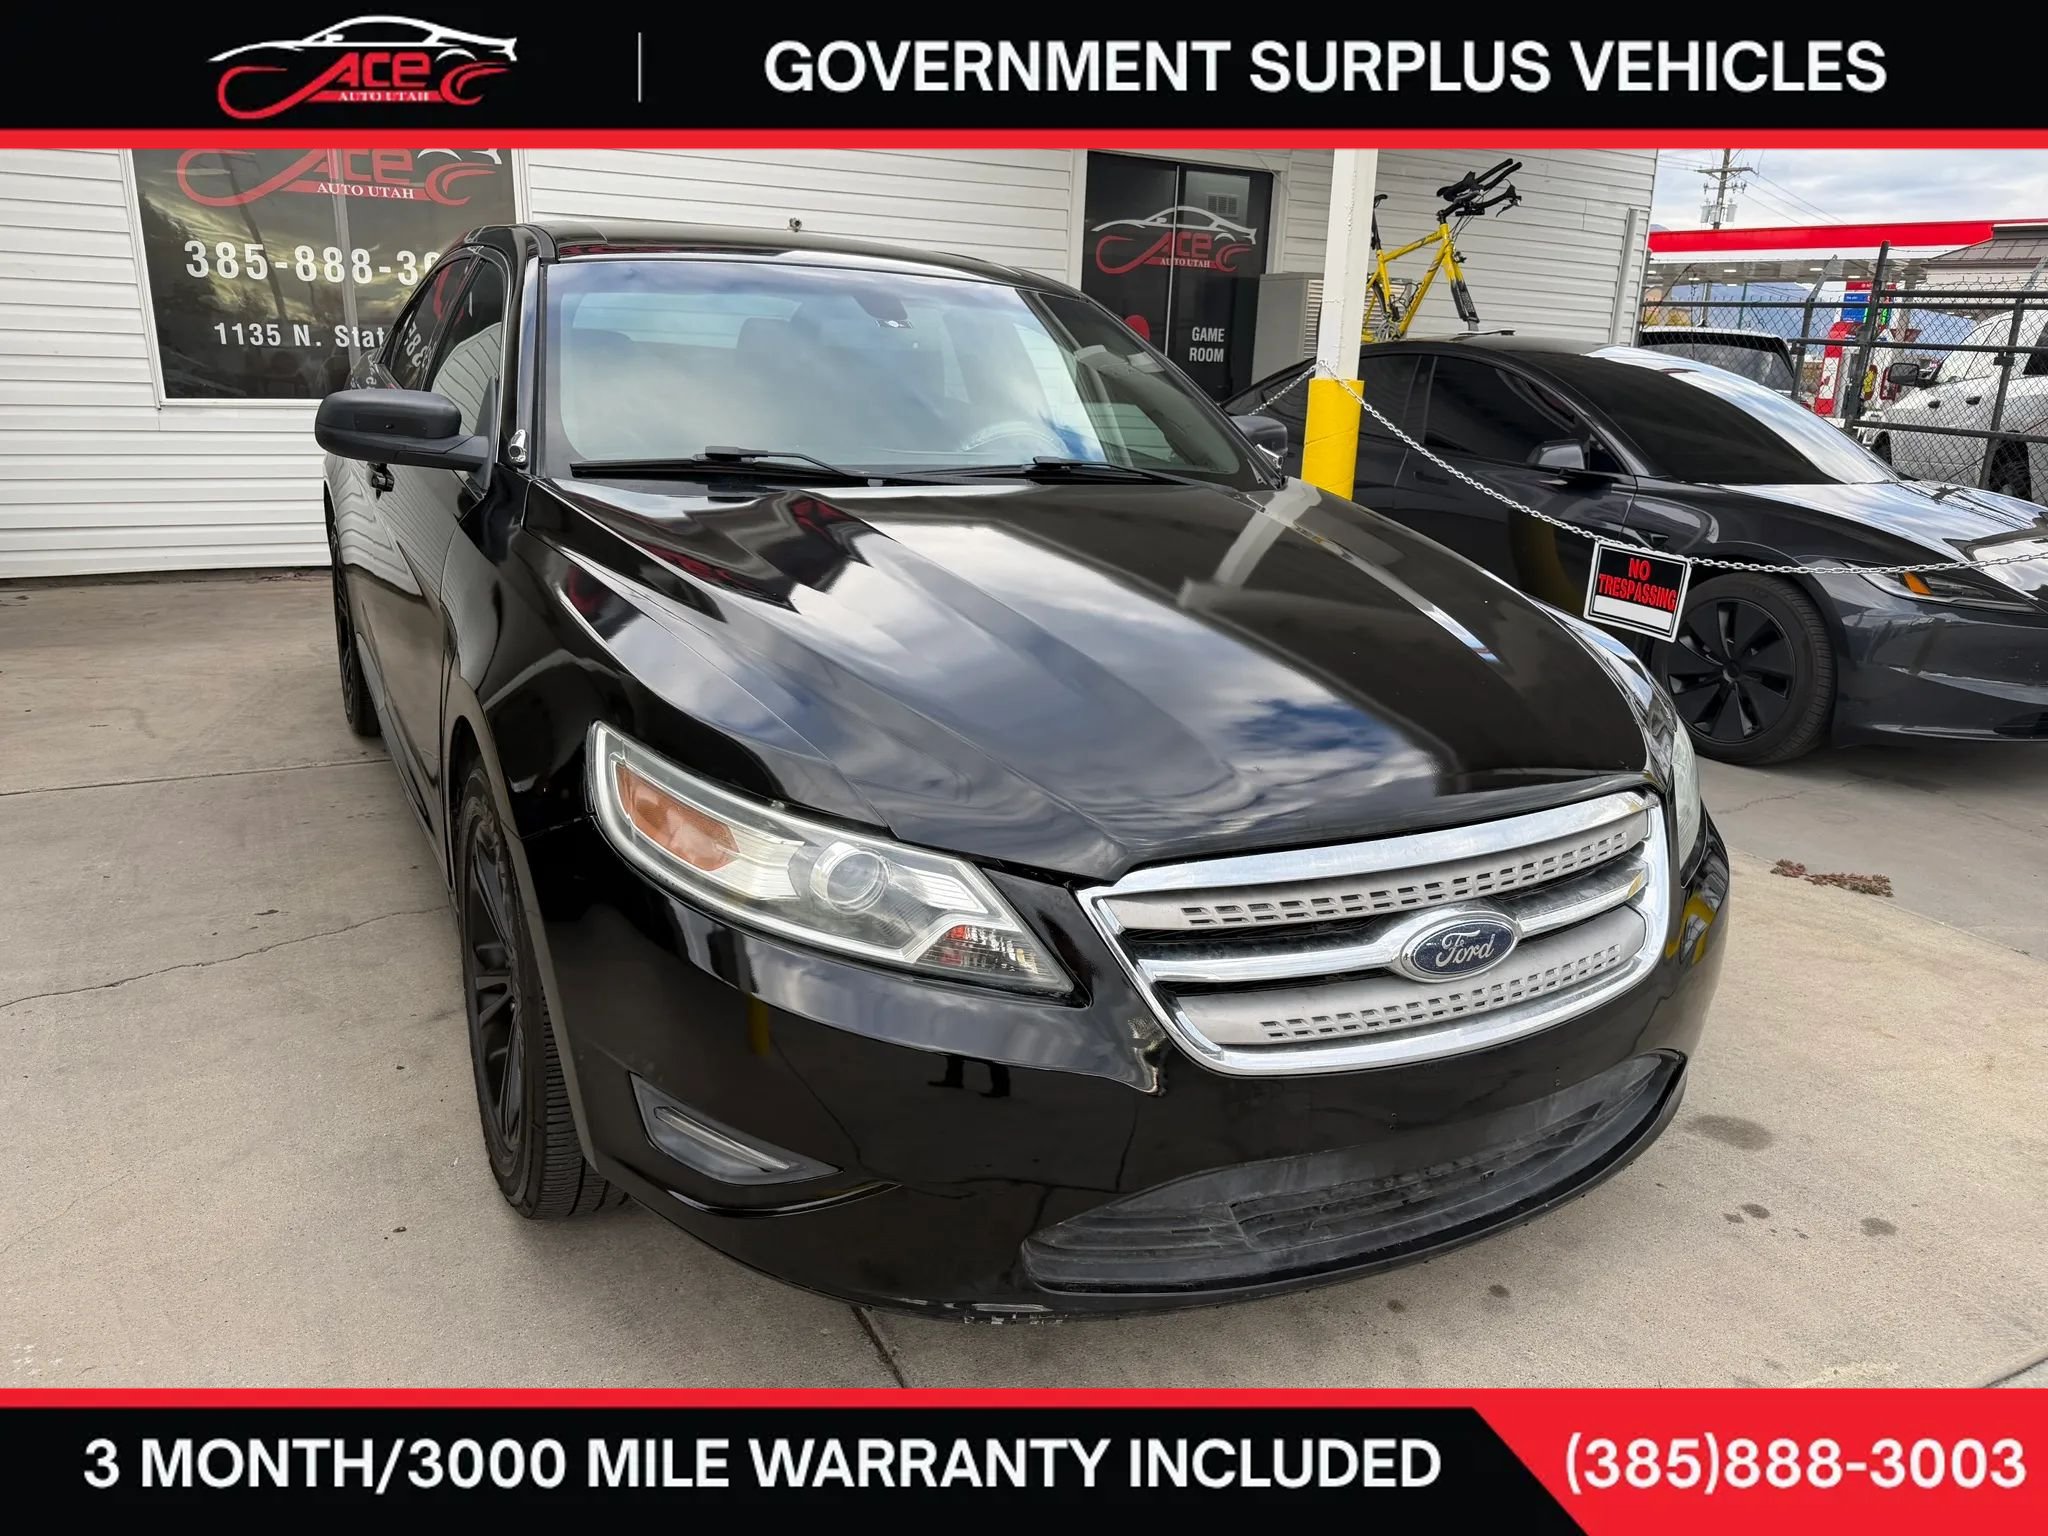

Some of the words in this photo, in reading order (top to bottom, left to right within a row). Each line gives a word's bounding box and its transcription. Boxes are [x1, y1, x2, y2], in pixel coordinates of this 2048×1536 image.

[317, 183, 364, 196] AUTO
[368, 187, 414, 199] UTAH
[1160, 257, 1185, 267] AUTO
[1187, 259, 1210, 268] UTAH
[214, 322, 281, 346] 1135
[293, 324, 322, 347] N.
[1192, 327, 1225, 342] GAME
[1189, 347, 1224, 362] ROOM
[1628, 558, 1651, 580] NO
[1598, 573, 1678, 611] TRESPASSING
[1435, 929, 1495, 968] Ford
